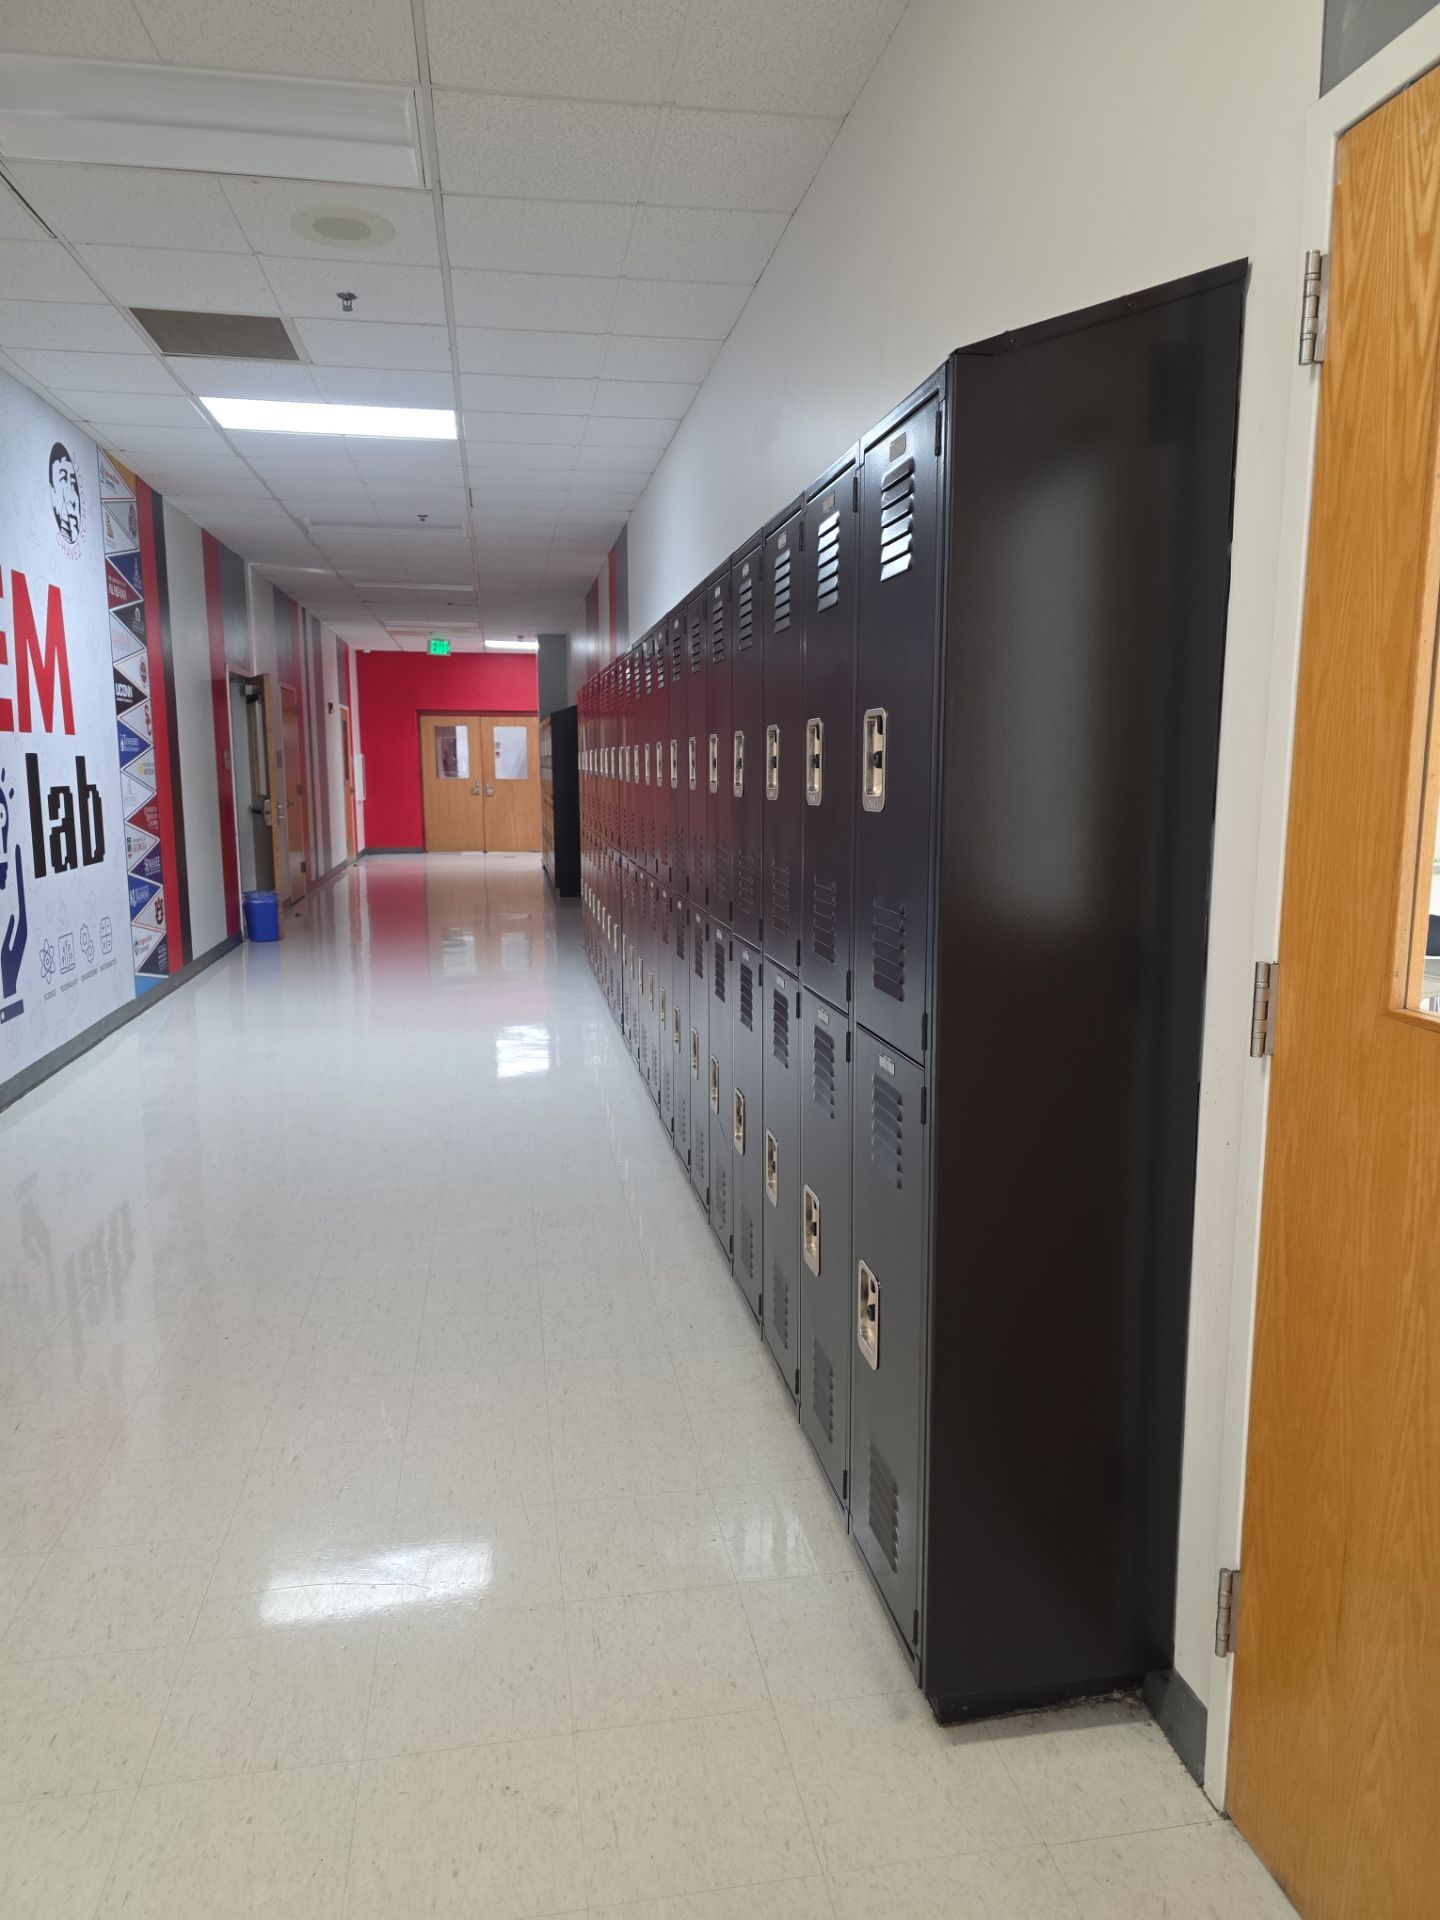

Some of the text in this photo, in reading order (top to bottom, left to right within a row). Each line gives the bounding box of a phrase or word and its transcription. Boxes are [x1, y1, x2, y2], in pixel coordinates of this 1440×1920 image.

[56, 531, 82, 561] CHAVEZ
[115, 683, 133, 698] UCONN
[25, 753, 106, 879] lab
